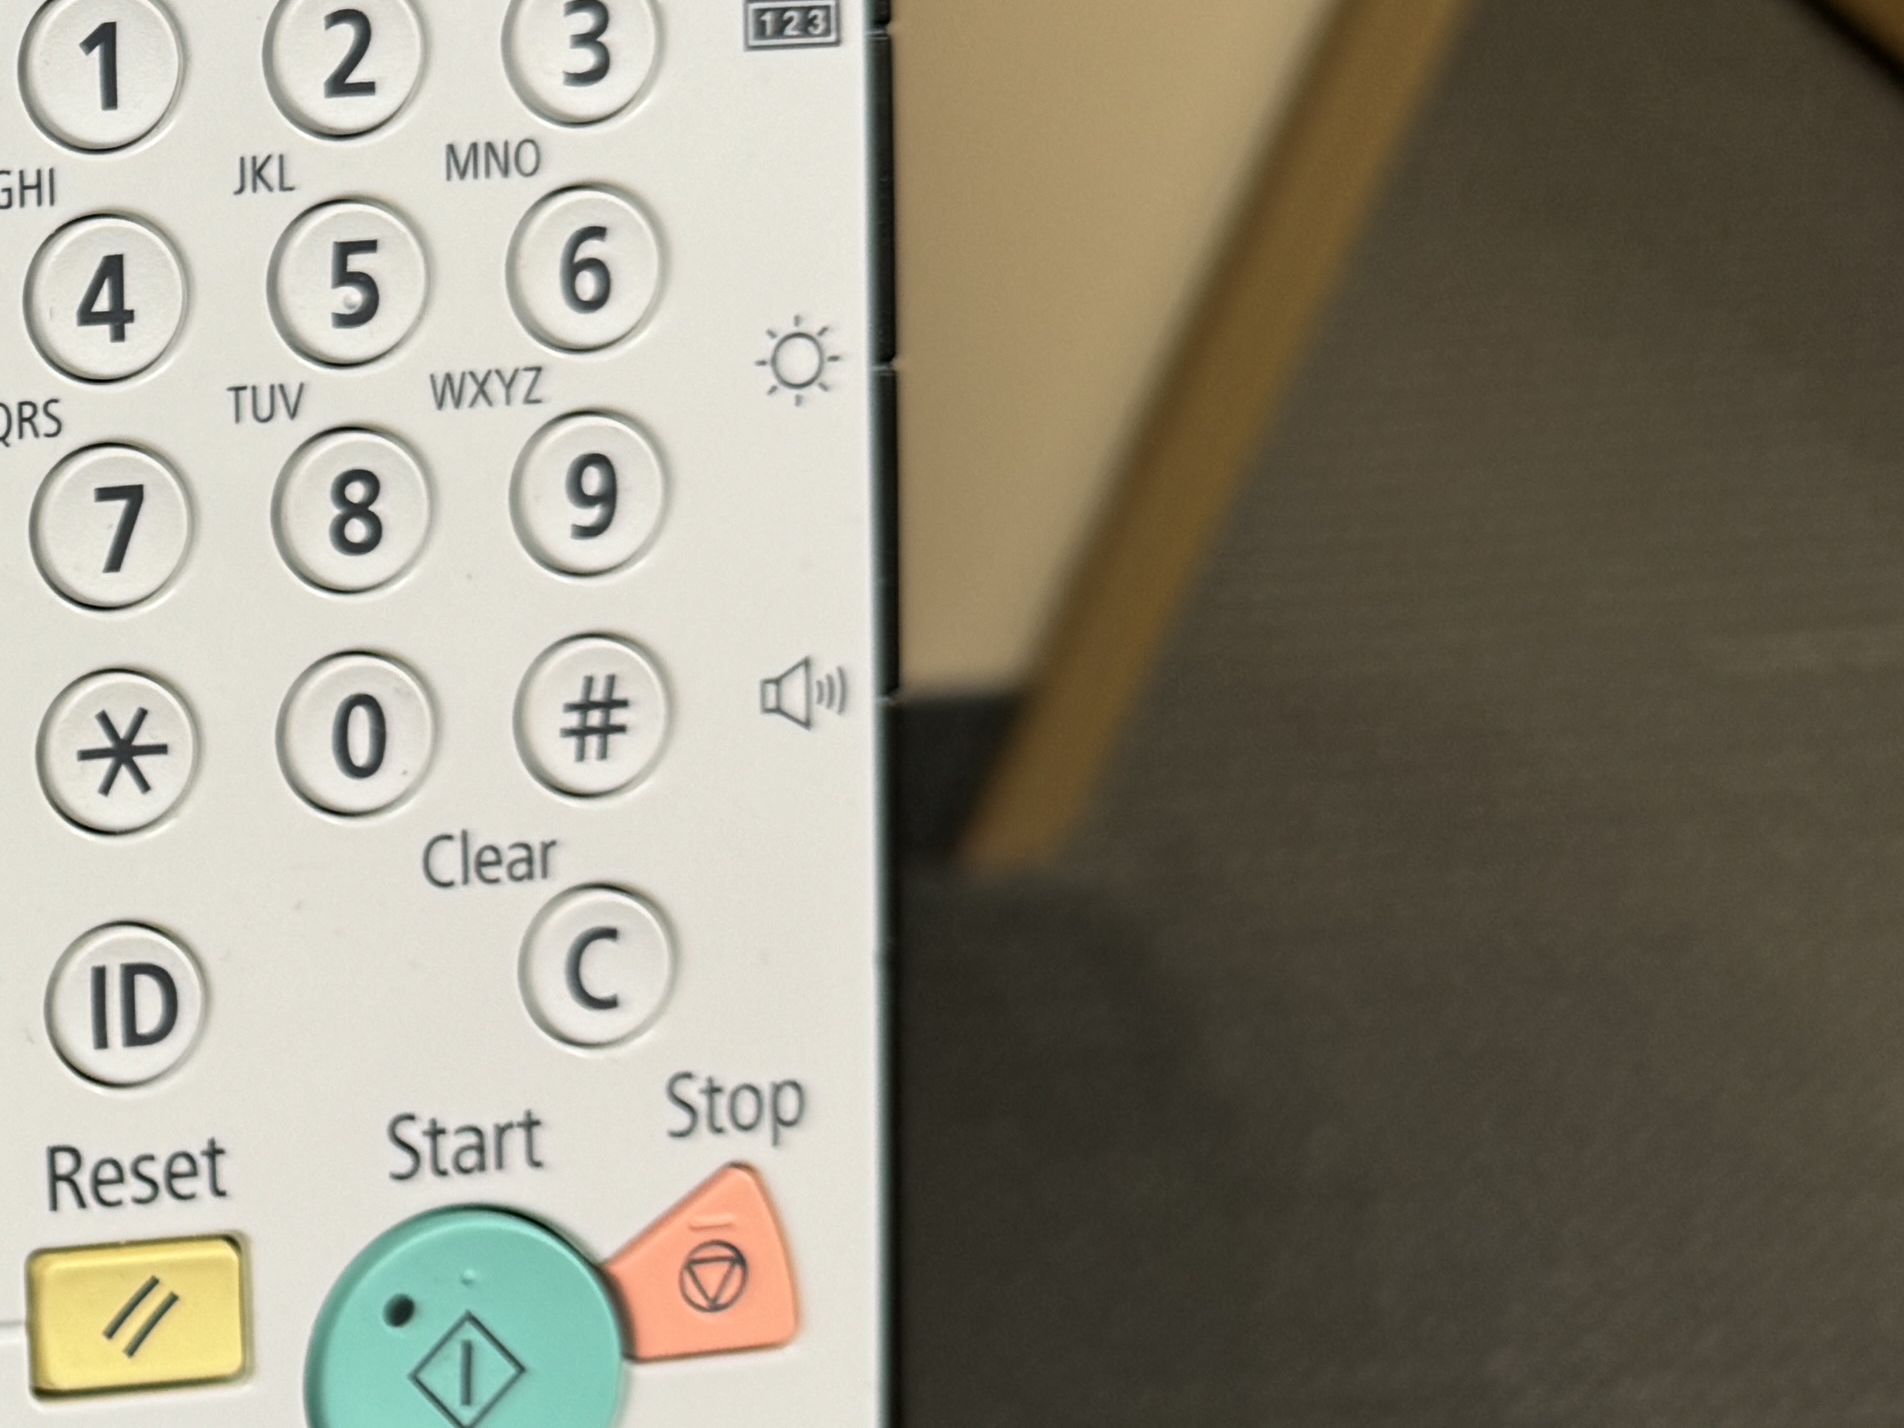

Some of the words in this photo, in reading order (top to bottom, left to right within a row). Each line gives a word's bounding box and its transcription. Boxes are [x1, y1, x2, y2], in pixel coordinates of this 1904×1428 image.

[78, 20, 119, 113] 1
[321, 7, 376, 98] 2
[233, 153, 296, 195] JKL
[445, 138, 542, 183] MNO
[76, 254, 135, 342] 4
[330, 238, 380, 329] 5
[560, 225, 611, 315] 6
[227, 382, 306, 425] TUV
[430, 366, 545, 411] WXYZ
[93, 483, 146, 573] 7
[328, 468, 383, 556] 8
[566, 452, 617, 540] 9
[332, 692, 387, 780] 0
[560, 674, 628, 763] #
[422, 832, 558, 889] Clear
[89, 961, 179, 1051] ID
[564, 927, 621, 1009] C
[388, 1107, 545, 1180] Start
[665, 1070, 806, 1140] Stop
[45, 1136, 229, 1211] Reset
